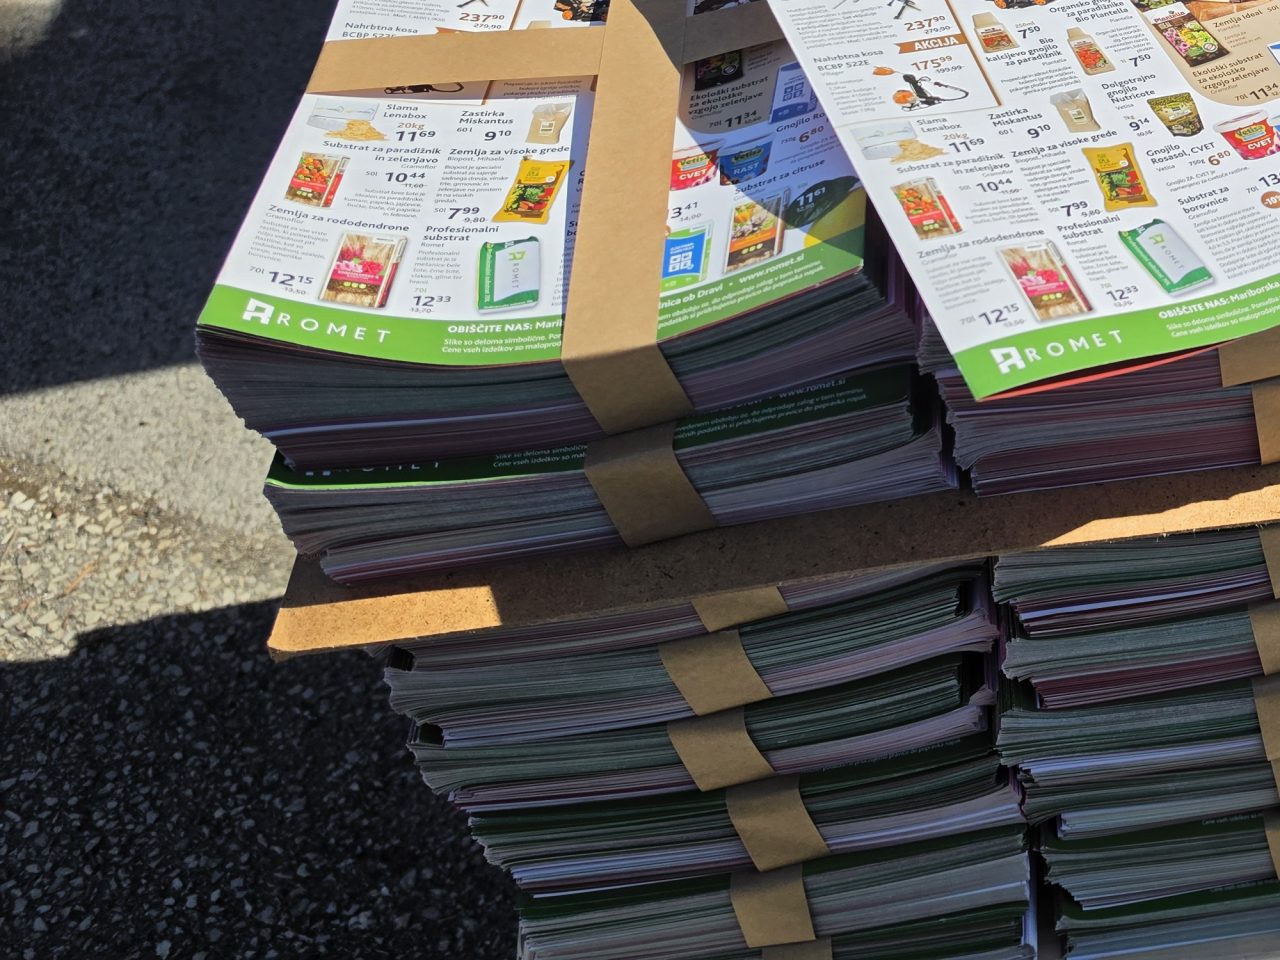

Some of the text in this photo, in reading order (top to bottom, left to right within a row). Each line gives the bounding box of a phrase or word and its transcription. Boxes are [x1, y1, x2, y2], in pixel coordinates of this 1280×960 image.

[1049, 0, 1090, 13] Organsko
[1077, 1, 1125, 17] paradižnike
[1090, 7, 1129, 21] Plantella
[1213, 15, 1241, 28] Zemlja
[1242, 9, 1263, 20] Ideal
[914, 37, 959, 51] AKCIJA
[813, 49, 884, 64] Nahrbtna kosa
[985, 43, 1058, 63] kalcijevo gnojilo
[1192, 52, 1264, 77] Ekološki substrat
[1101, 73, 1156, 90] Dolgotrajno
[1202, 66, 1270, 90] vzgojo zelenjave
[1210, 66, 1246, 82] ekološko
[1110, 89, 1156, 104] Nutricote
[386, 103, 419, 111] Slama
[383, 111, 428, 120] Lenabox
[459, 117, 514, 125] Miskantus
[992, 112, 1044, 128] Miskantus
[1190, 142, 1216, 155] CVET
[1246, 137, 1272, 150] CVET
[386, 146, 442, 157] paradižnik
[388, 156, 439, 165] zelenjavo
[679, 169, 708, 180] CVET
[963, 162, 1010, 175] zelenjavo
[1183, 195, 1230, 214] borovnice
[326, 216, 410, 232] rododendrone
[425, 225, 499, 234] Profesionalni
[1057, 214, 1121, 232] Profesionalni
[971, 228, 1046, 246] rododendrone
[1158, 299, 1206, 320] OBIŠČITE
[1206, 295, 1230, 312] NAS:
[1231, 278, 1280, 302] Mariborska
[277, 312, 391, 344] ROMET
[447, 321, 533, 333] OBIŠČITE NAS:
[1024, 329, 1124, 363] ROMET
